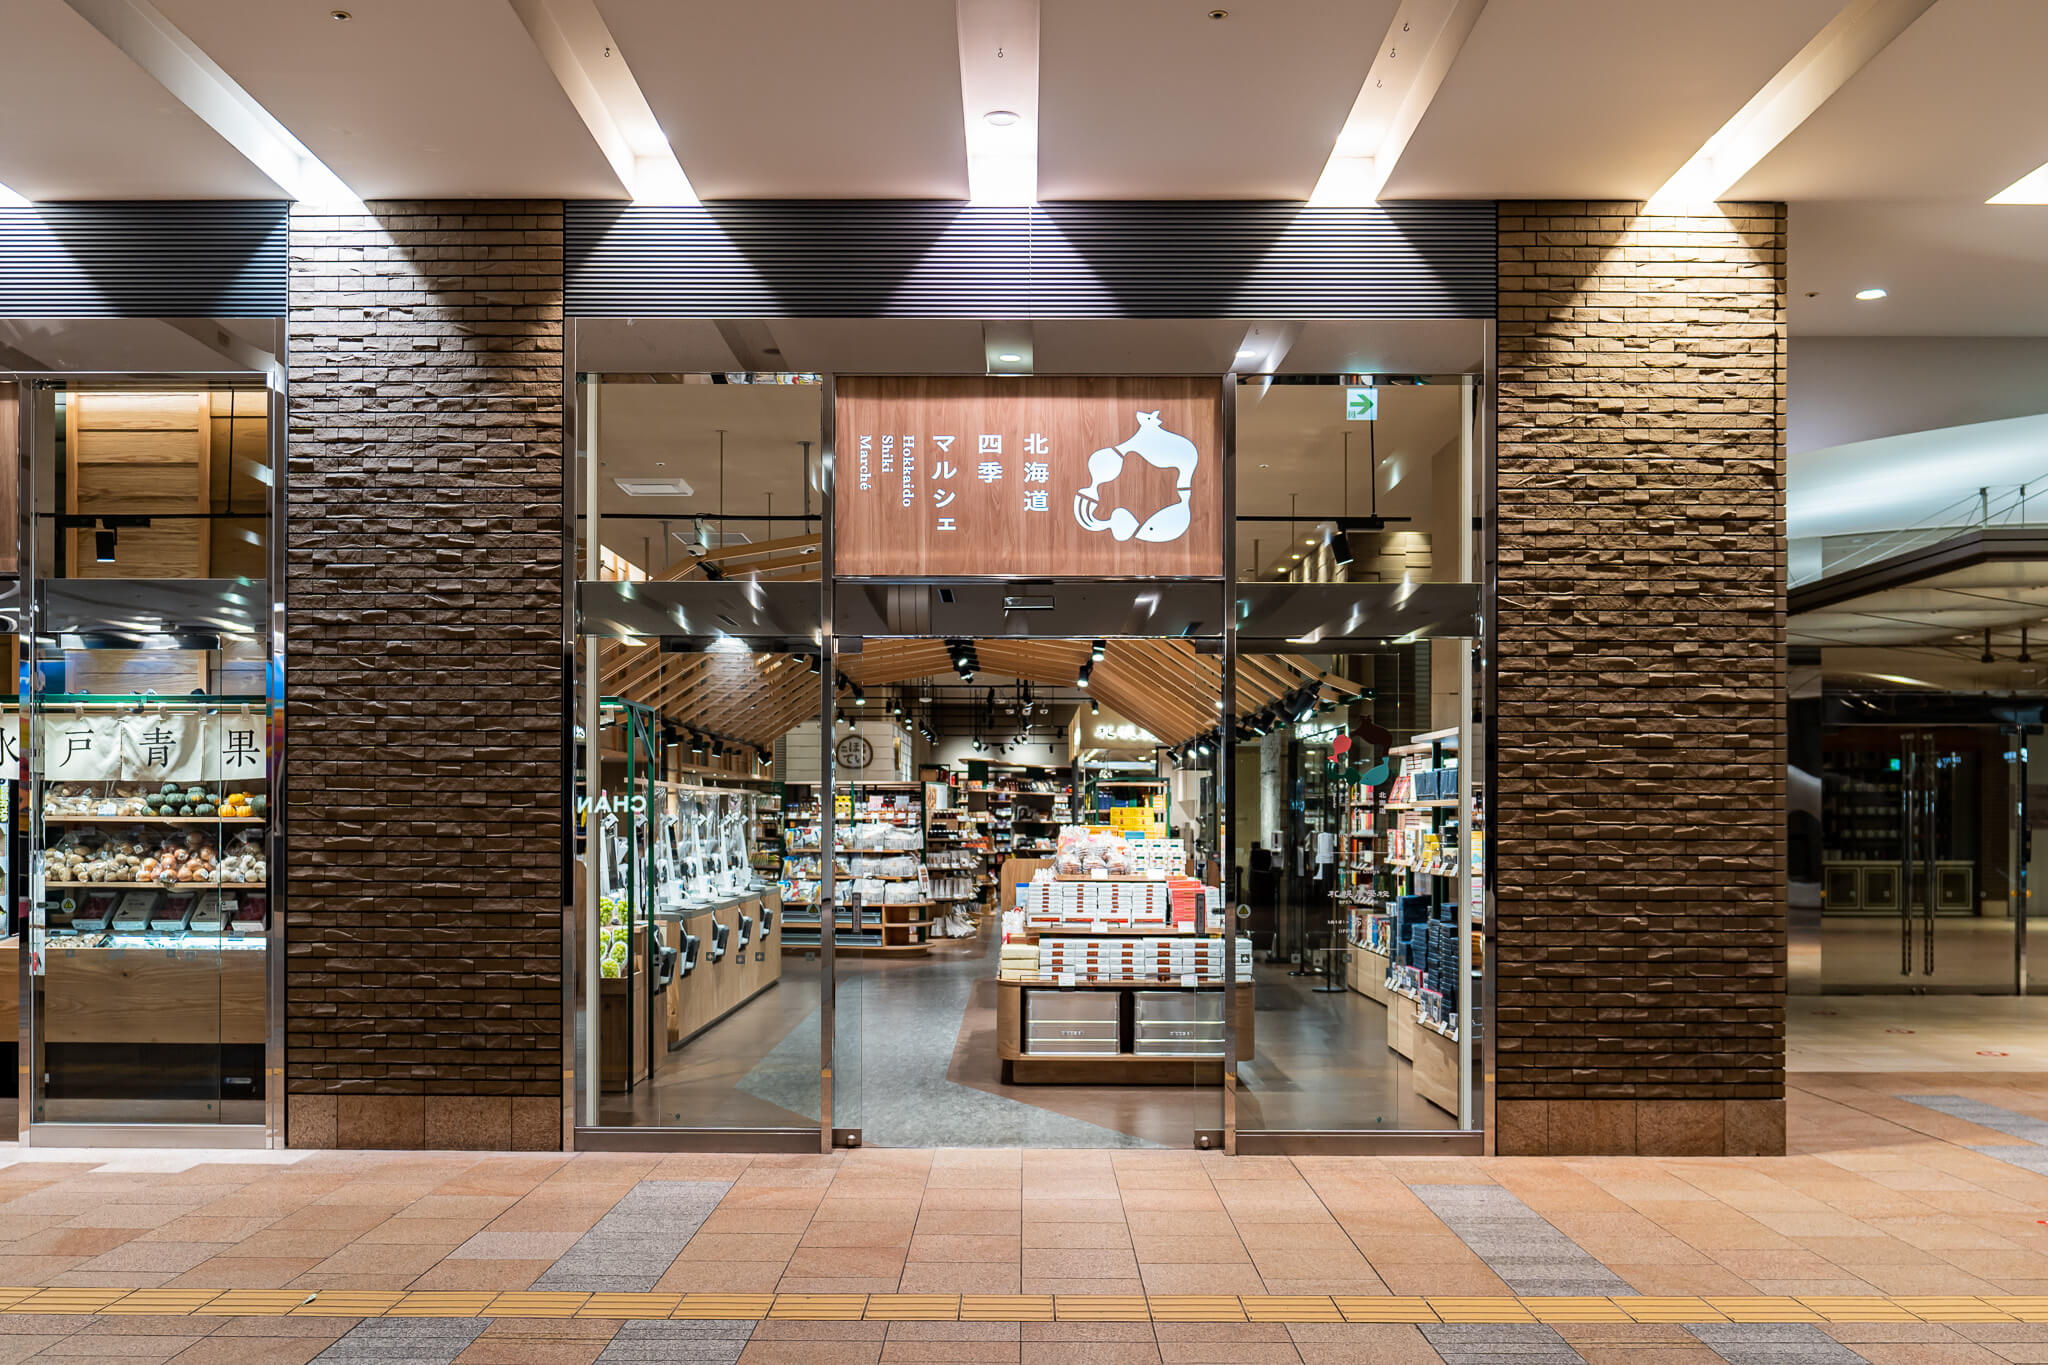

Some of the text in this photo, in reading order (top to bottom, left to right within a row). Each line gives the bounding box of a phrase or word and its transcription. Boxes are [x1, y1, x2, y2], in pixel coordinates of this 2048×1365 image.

[859, 434, 873, 491] Marché
[881, 434, 895, 474] Shiki
[902, 434, 916, 508] Hokkaido
[931, 434, 958, 532] マルシェ
[977, 434, 1003, 484] 四季
[1023, 432, 1050, 512] 北海道
